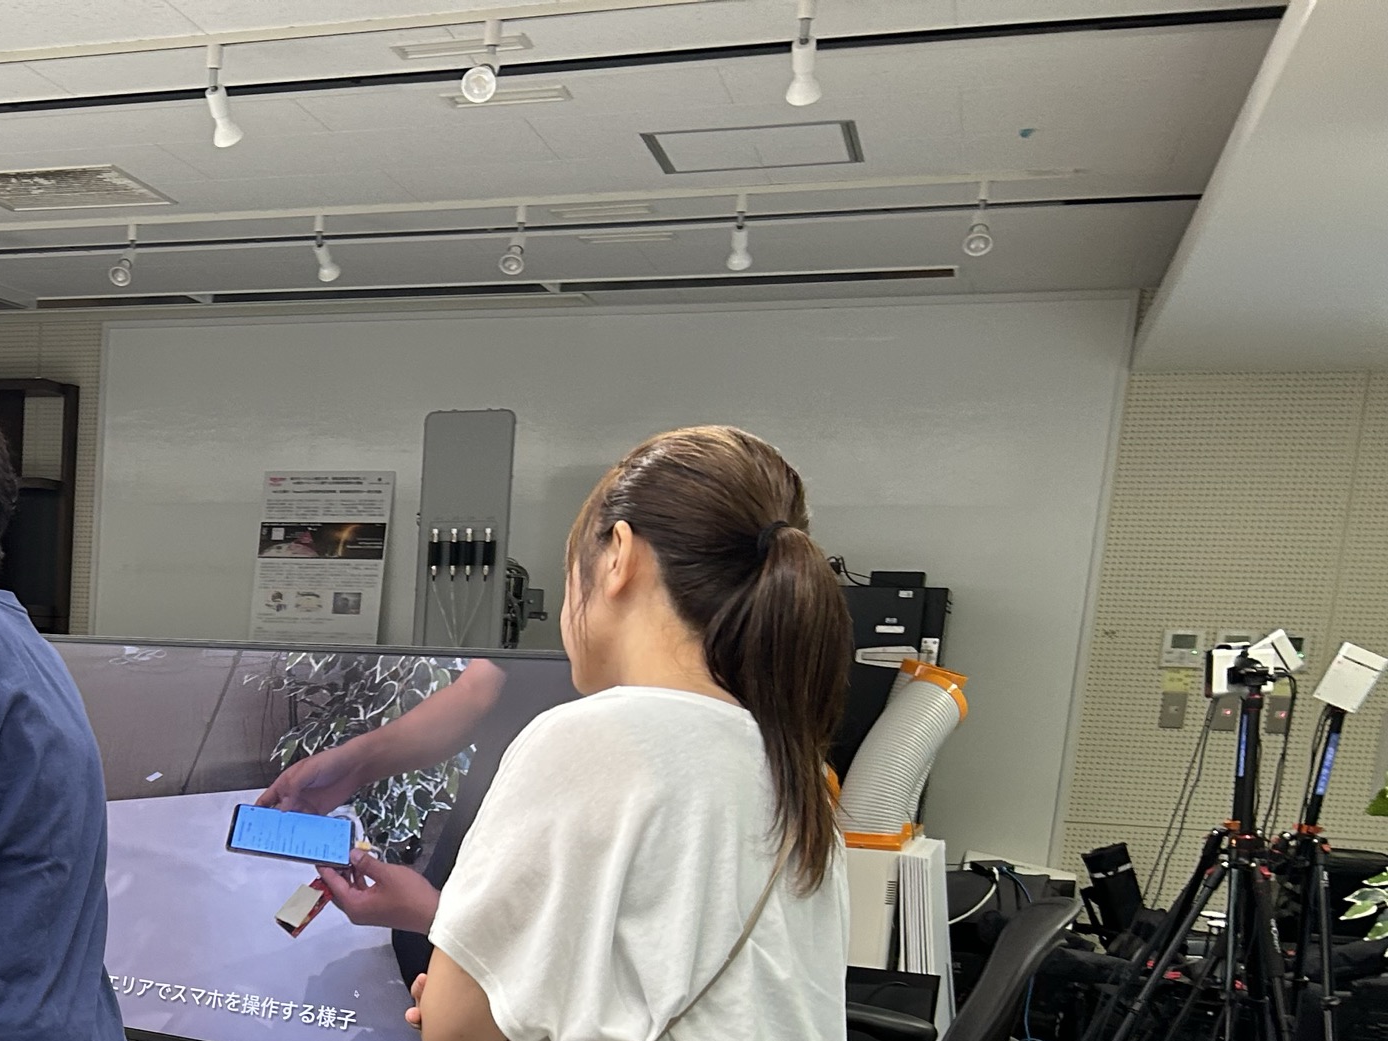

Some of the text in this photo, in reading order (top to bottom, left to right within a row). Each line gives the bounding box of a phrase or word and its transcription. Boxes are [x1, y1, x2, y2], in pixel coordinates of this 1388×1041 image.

[107, 974, 358, 1031] エリアでスマホを操作する様子
